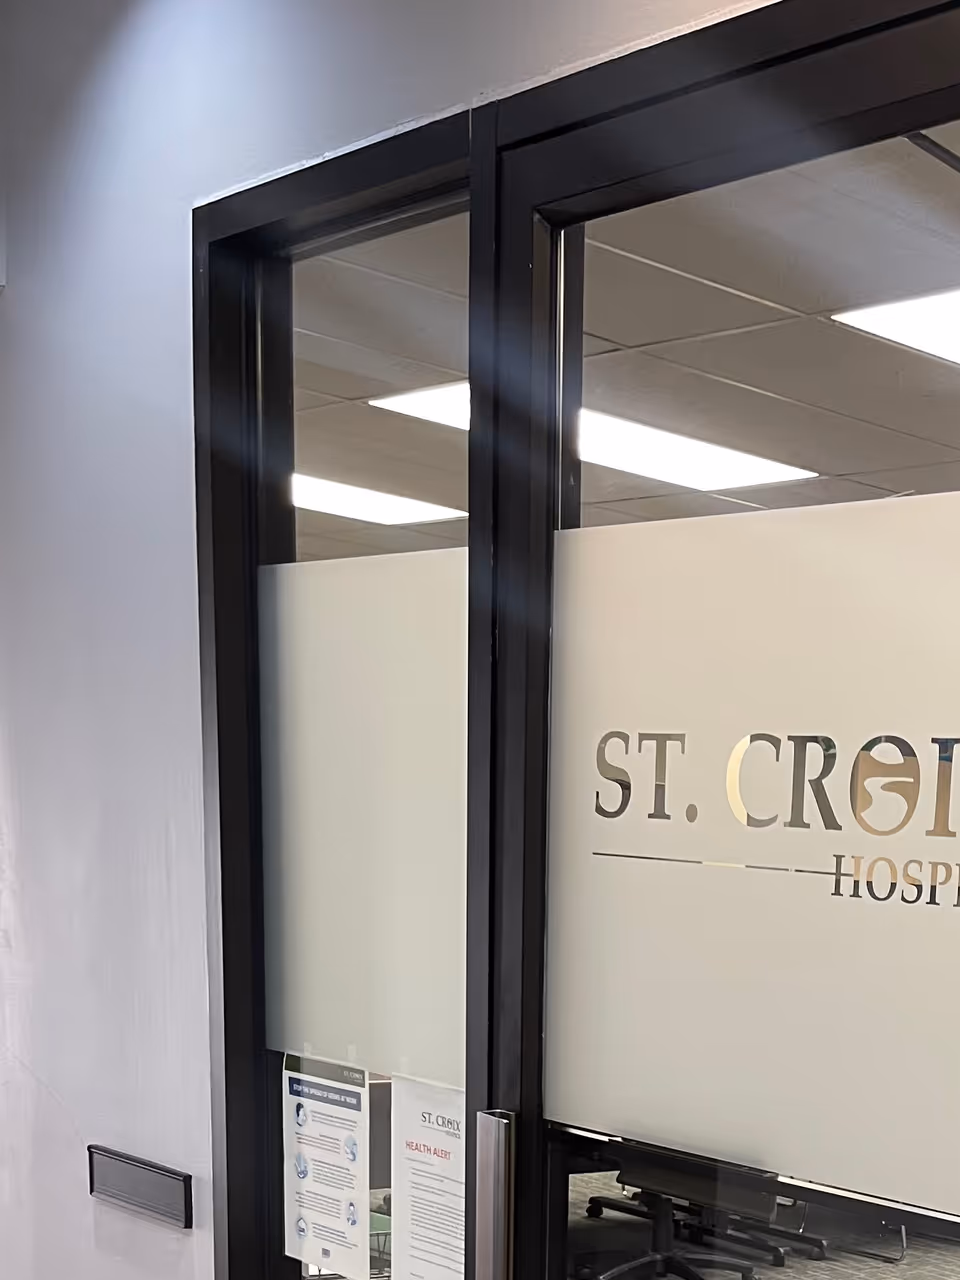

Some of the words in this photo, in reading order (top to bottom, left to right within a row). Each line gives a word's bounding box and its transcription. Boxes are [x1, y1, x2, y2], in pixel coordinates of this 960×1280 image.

[593, 729, 699, 823] ST.
[405, 1140, 432, 1155] HEALTH
[433, 1147, 451, 1161] ALERT
